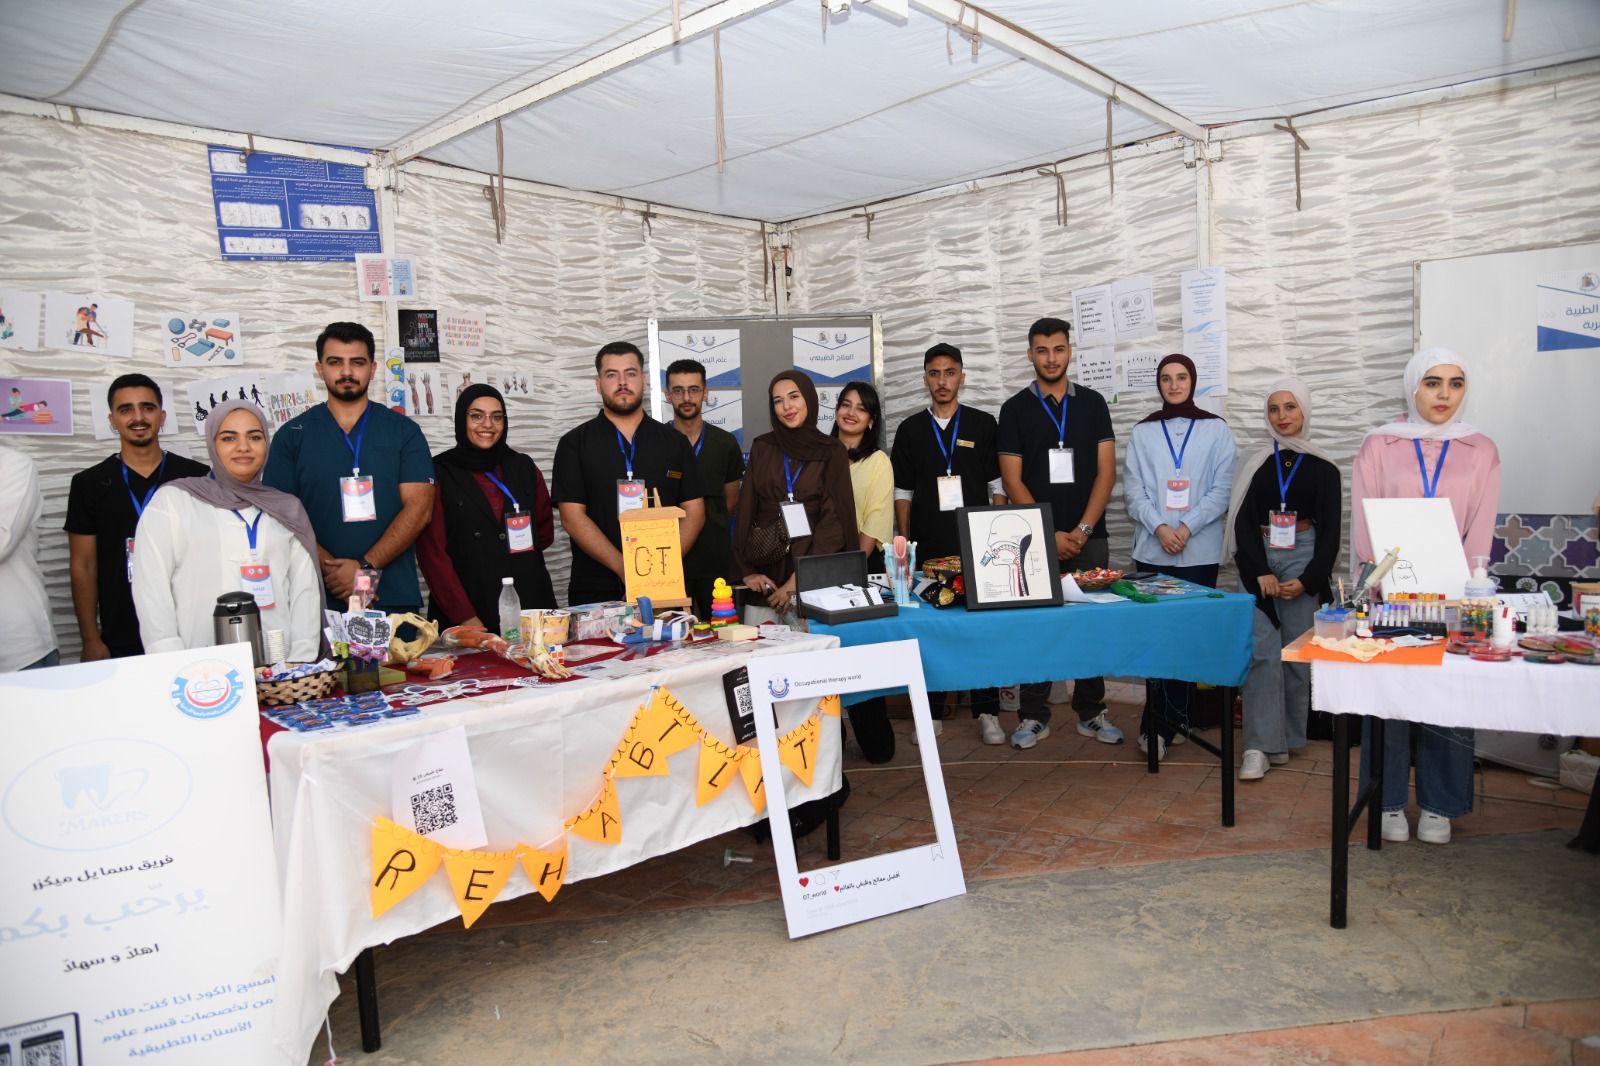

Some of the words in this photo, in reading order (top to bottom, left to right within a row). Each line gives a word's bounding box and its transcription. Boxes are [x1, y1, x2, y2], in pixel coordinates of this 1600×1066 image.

[794, 677, 828, 687] Occupational
[828, 676, 847, 684] therapy
[138, 854, 174, 871] فريق
[76, 864, 134, 883] سمايل
[872, 876, 886, 886] معالج
[32, 876, 73, 891] ميكزر
[110, 954, 121, 964] و
[195, 983, 232, 1001] الكود
[236, 975, 276, 994] امسح
[138, 998, 169, 1014] كنت
[172, 993, 192, 1006] اذا
[252, 997, 274, 1009] من
[94, 1007, 136, 1025] طالب
[180, 1002, 249, 1025] تخصصات
[143, 1017, 177, 1035] قسم
[200, 1020, 253, 1043] الأسنان
[102, 1027, 139, 1044] علوم
[128, 1034, 199, 1058] التطبيقية
